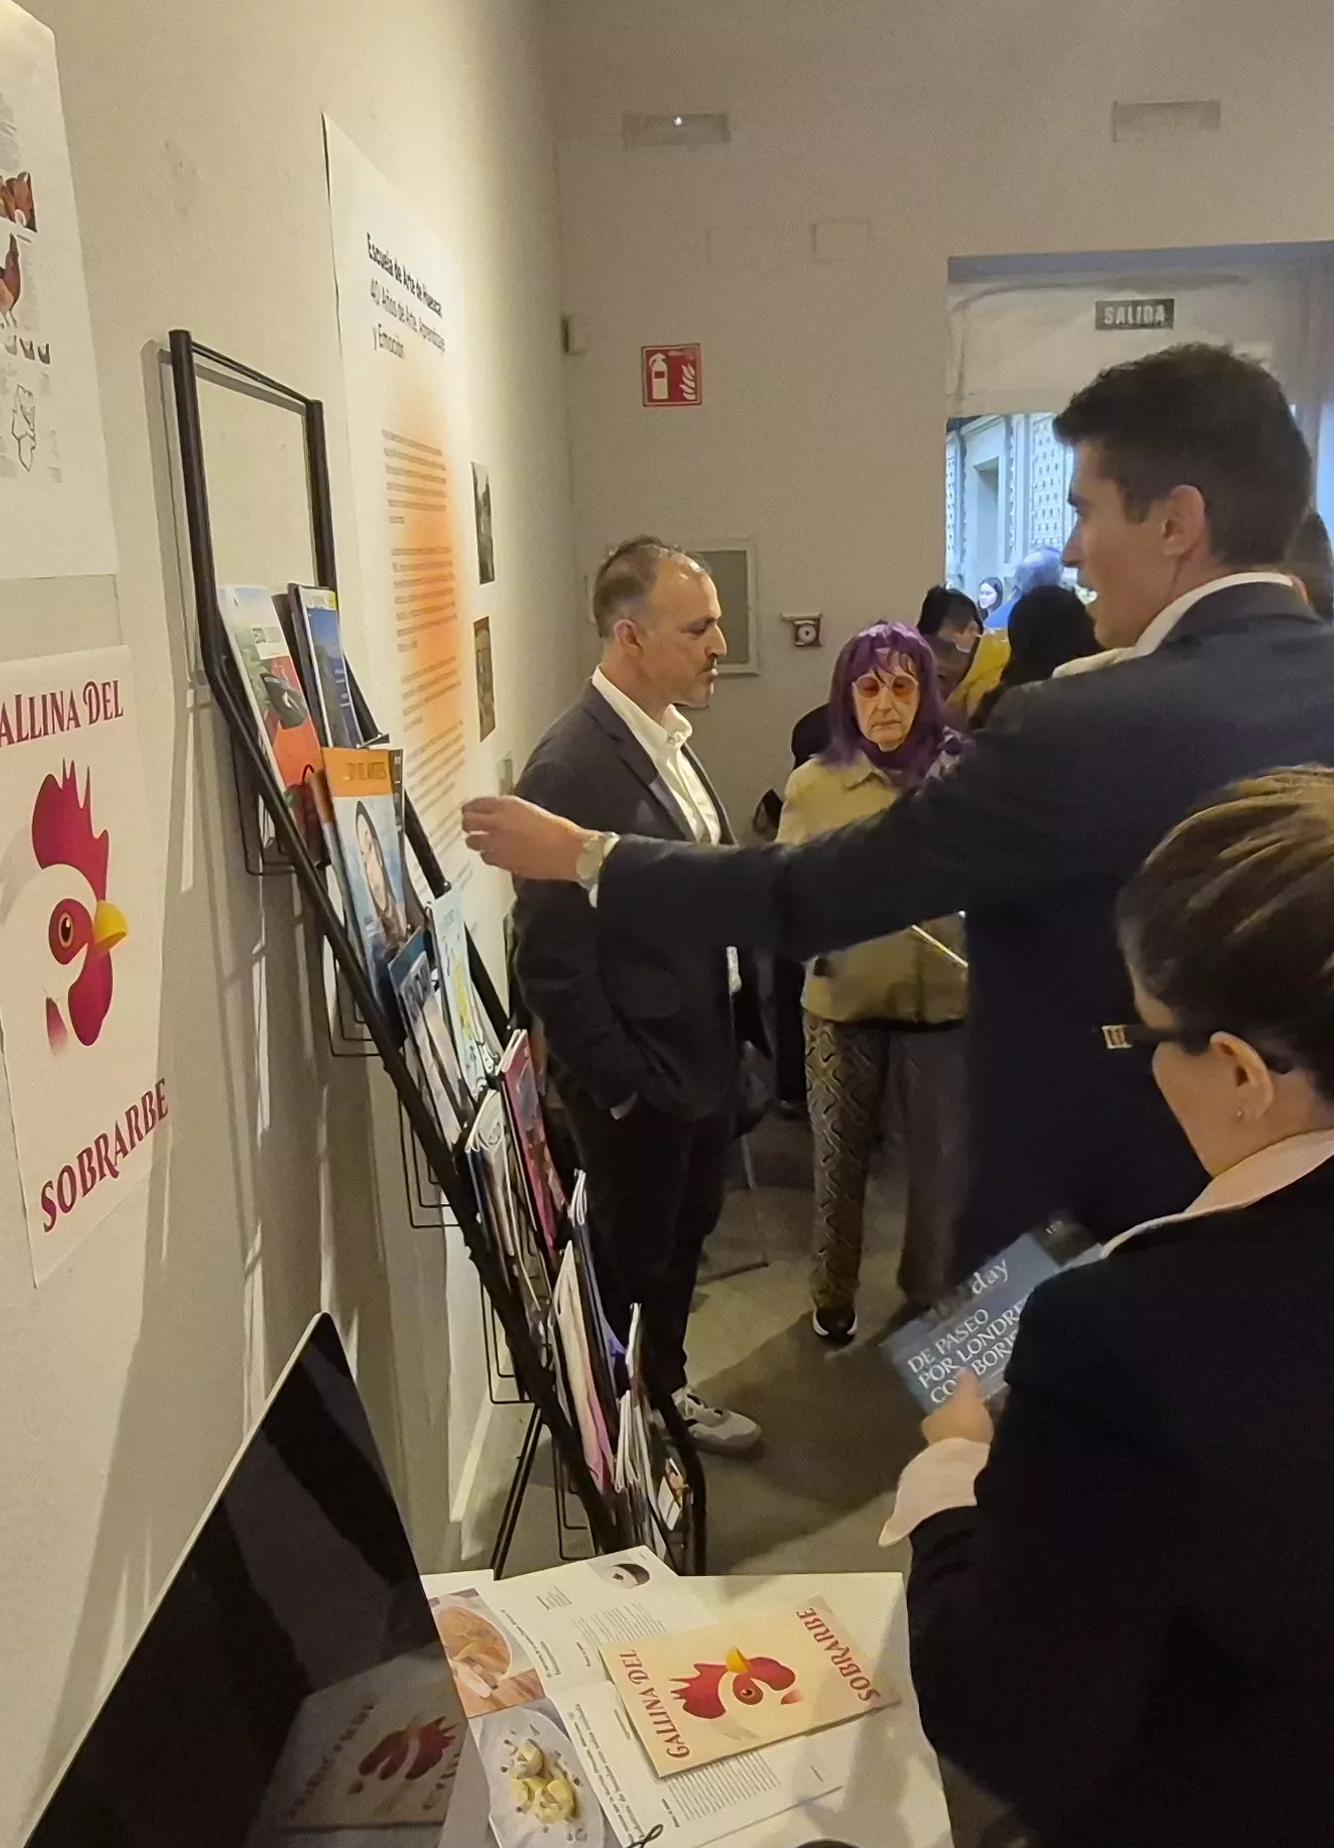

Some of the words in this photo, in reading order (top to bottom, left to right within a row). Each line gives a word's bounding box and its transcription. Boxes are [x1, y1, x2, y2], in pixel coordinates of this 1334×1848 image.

[1103, 304, 1165, 326] SALIDA
[83, 680, 124, 725] DEL
[41, 1077, 168, 1233] SOBRARBE
[907, 1346, 937, 1374] DE
[934, 1308, 989, 1356] PASEO
[917, 1357, 960, 1389] POR
[930, 1379, 958, 1404] CO
[619, 1648, 650, 1686] DEL
[796, 1607, 881, 1702] SOBRARBE
[638, 1687, 691, 1759] GALLINA
